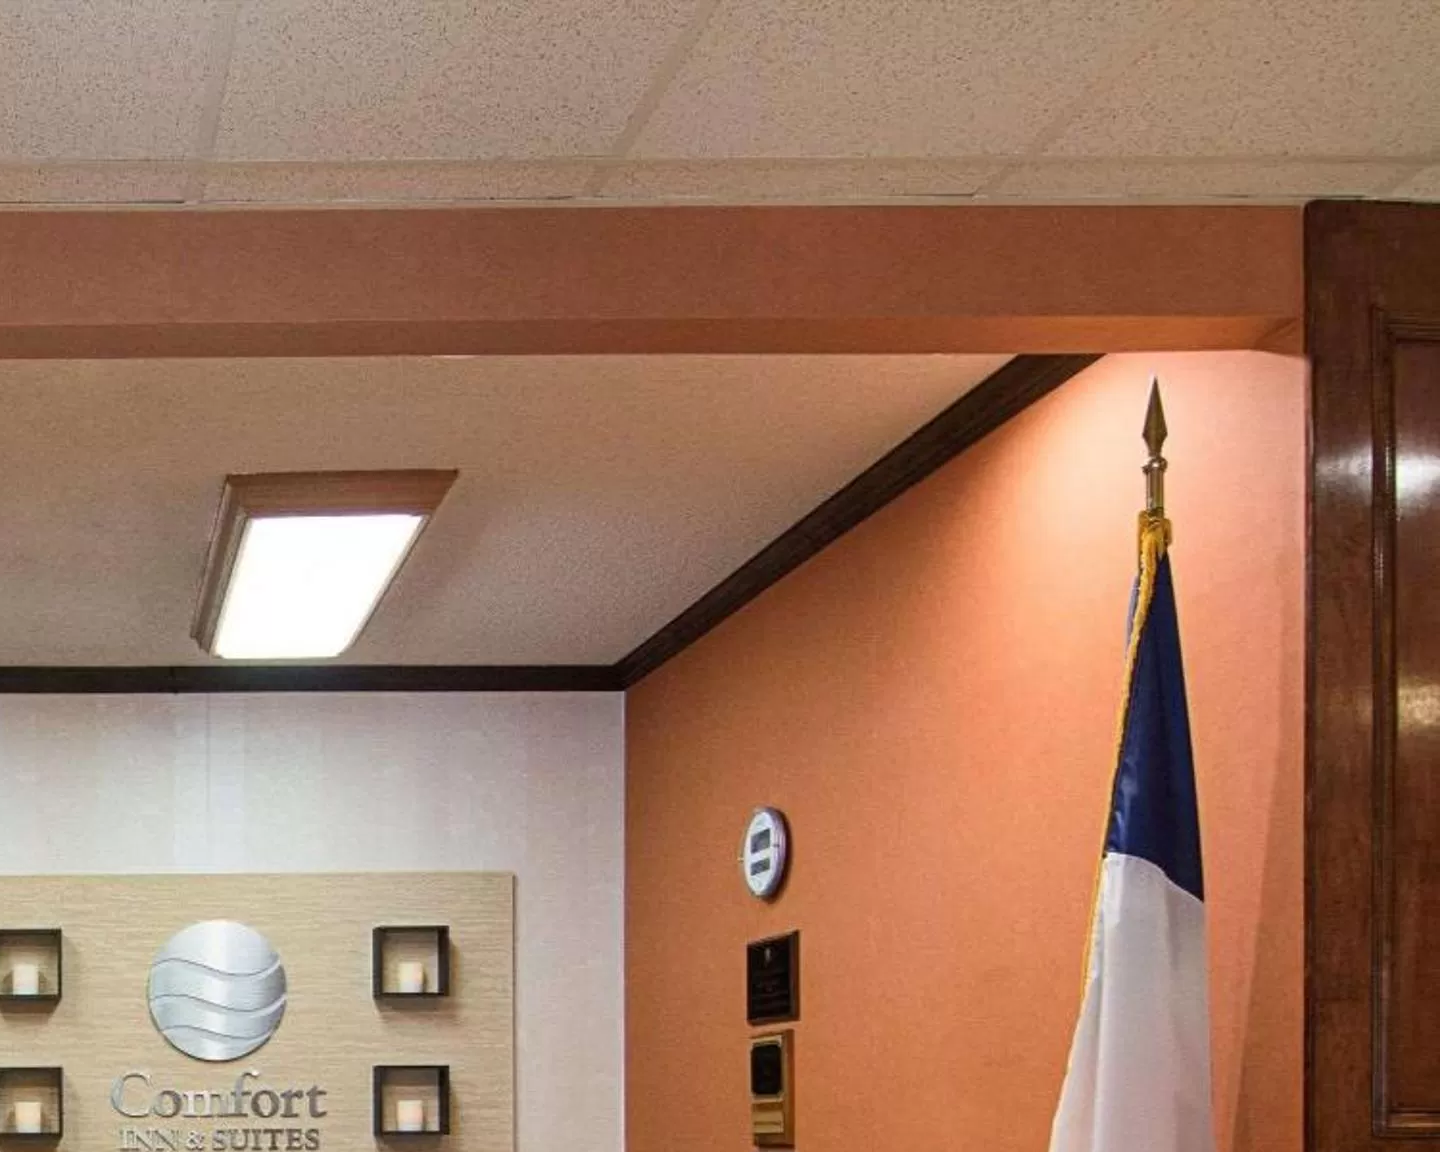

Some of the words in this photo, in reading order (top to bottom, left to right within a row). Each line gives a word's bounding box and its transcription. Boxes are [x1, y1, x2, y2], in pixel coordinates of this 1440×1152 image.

[109, 1069, 328, 1117] Comfort
[119, 1129, 180, 1152] INN
[186, 1131, 205, 1151] &
[211, 1129, 320, 1152] SUITES
